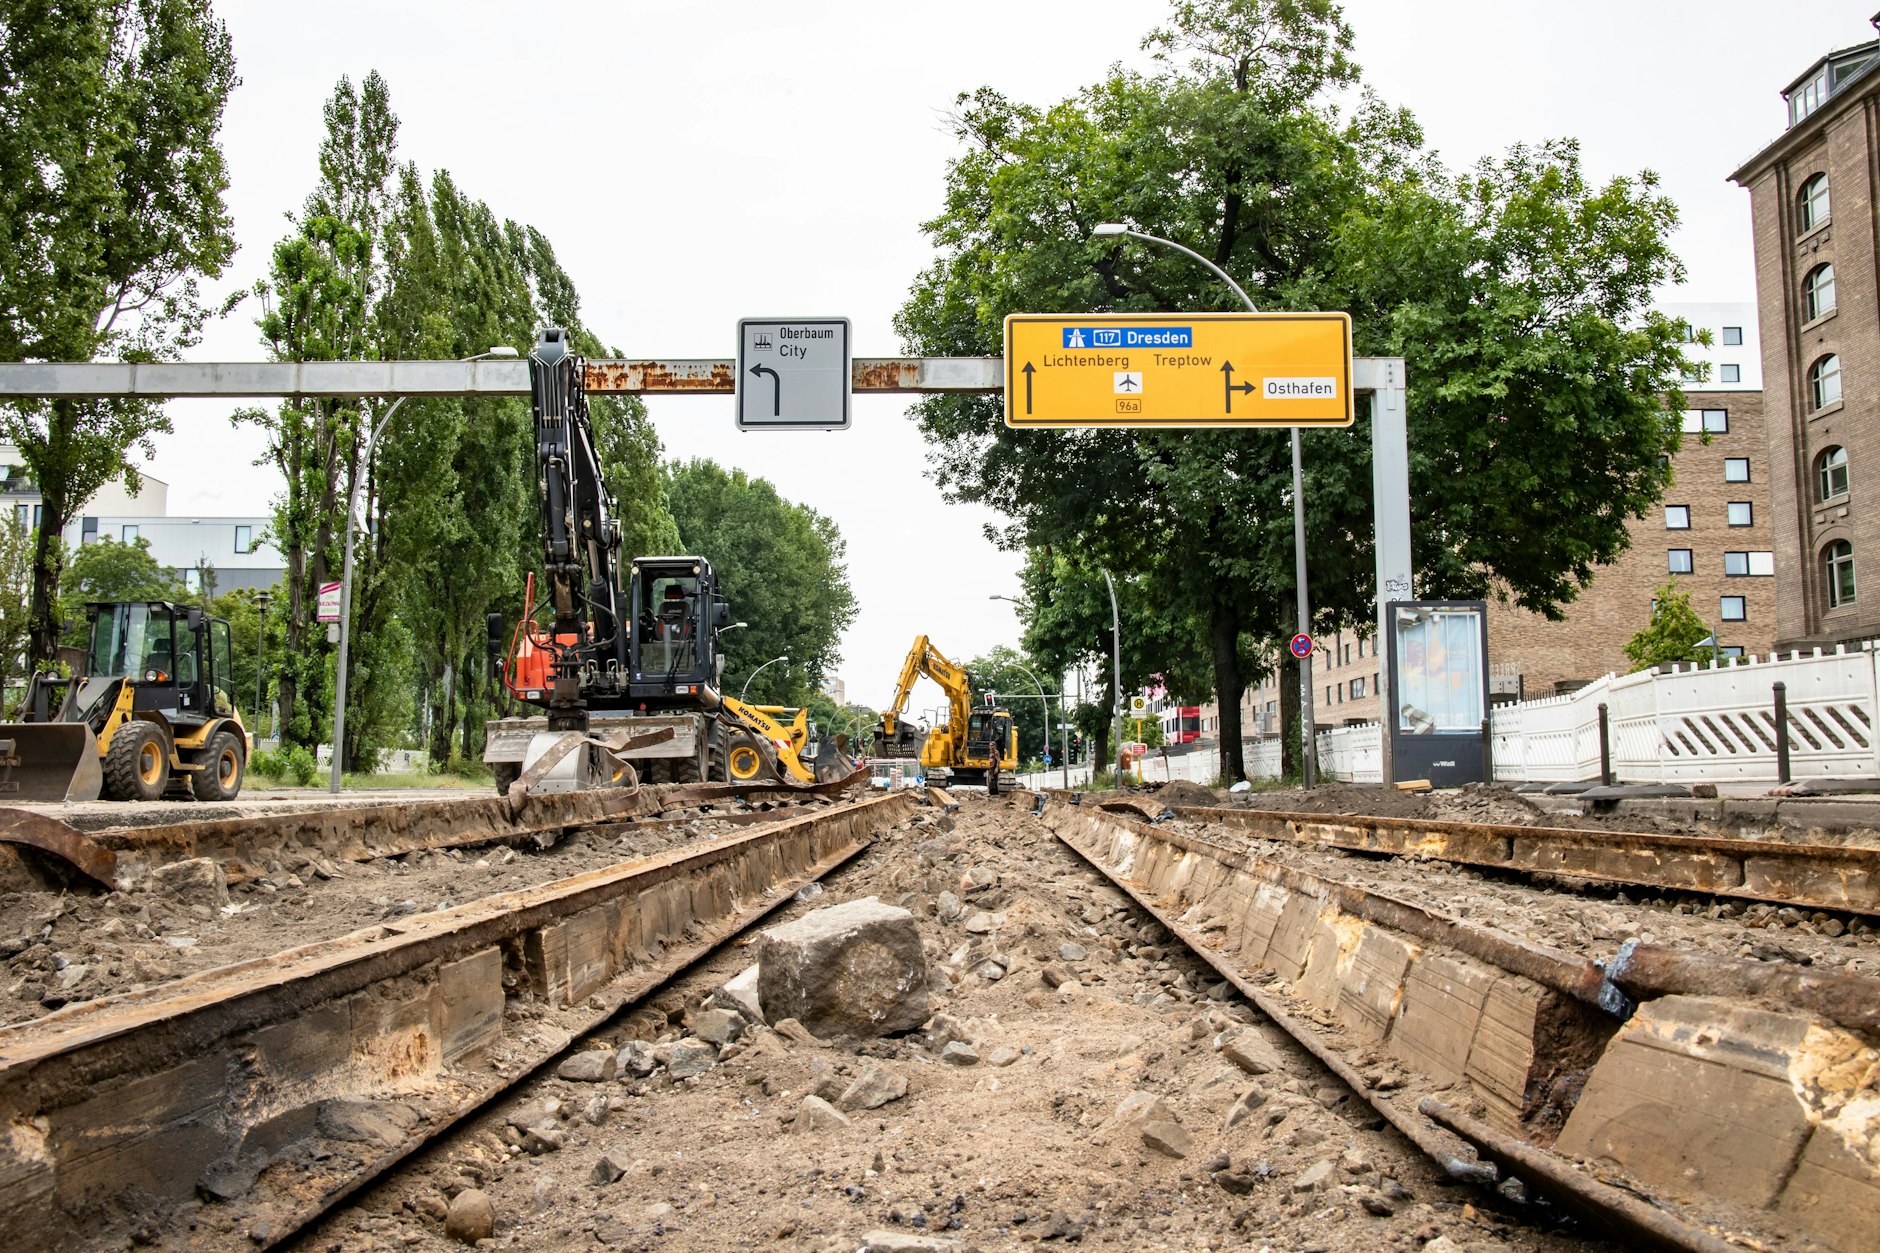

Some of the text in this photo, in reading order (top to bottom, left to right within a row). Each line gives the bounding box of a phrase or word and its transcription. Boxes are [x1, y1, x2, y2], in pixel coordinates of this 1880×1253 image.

[780, 327, 834, 339] Oberbaum
[1098, 331, 1189, 345] 117 Dresden
[779, 344, 807, 360] City
[1043, 353, 1130, 369] Lichtenberg
[1153, 354, 1212, 367] Treptow
[1267, 381, 1332, 395] Osthafen
[1119, 401, 1138, 412] 96a
[738, 706, 771, 731] KOMATSU
